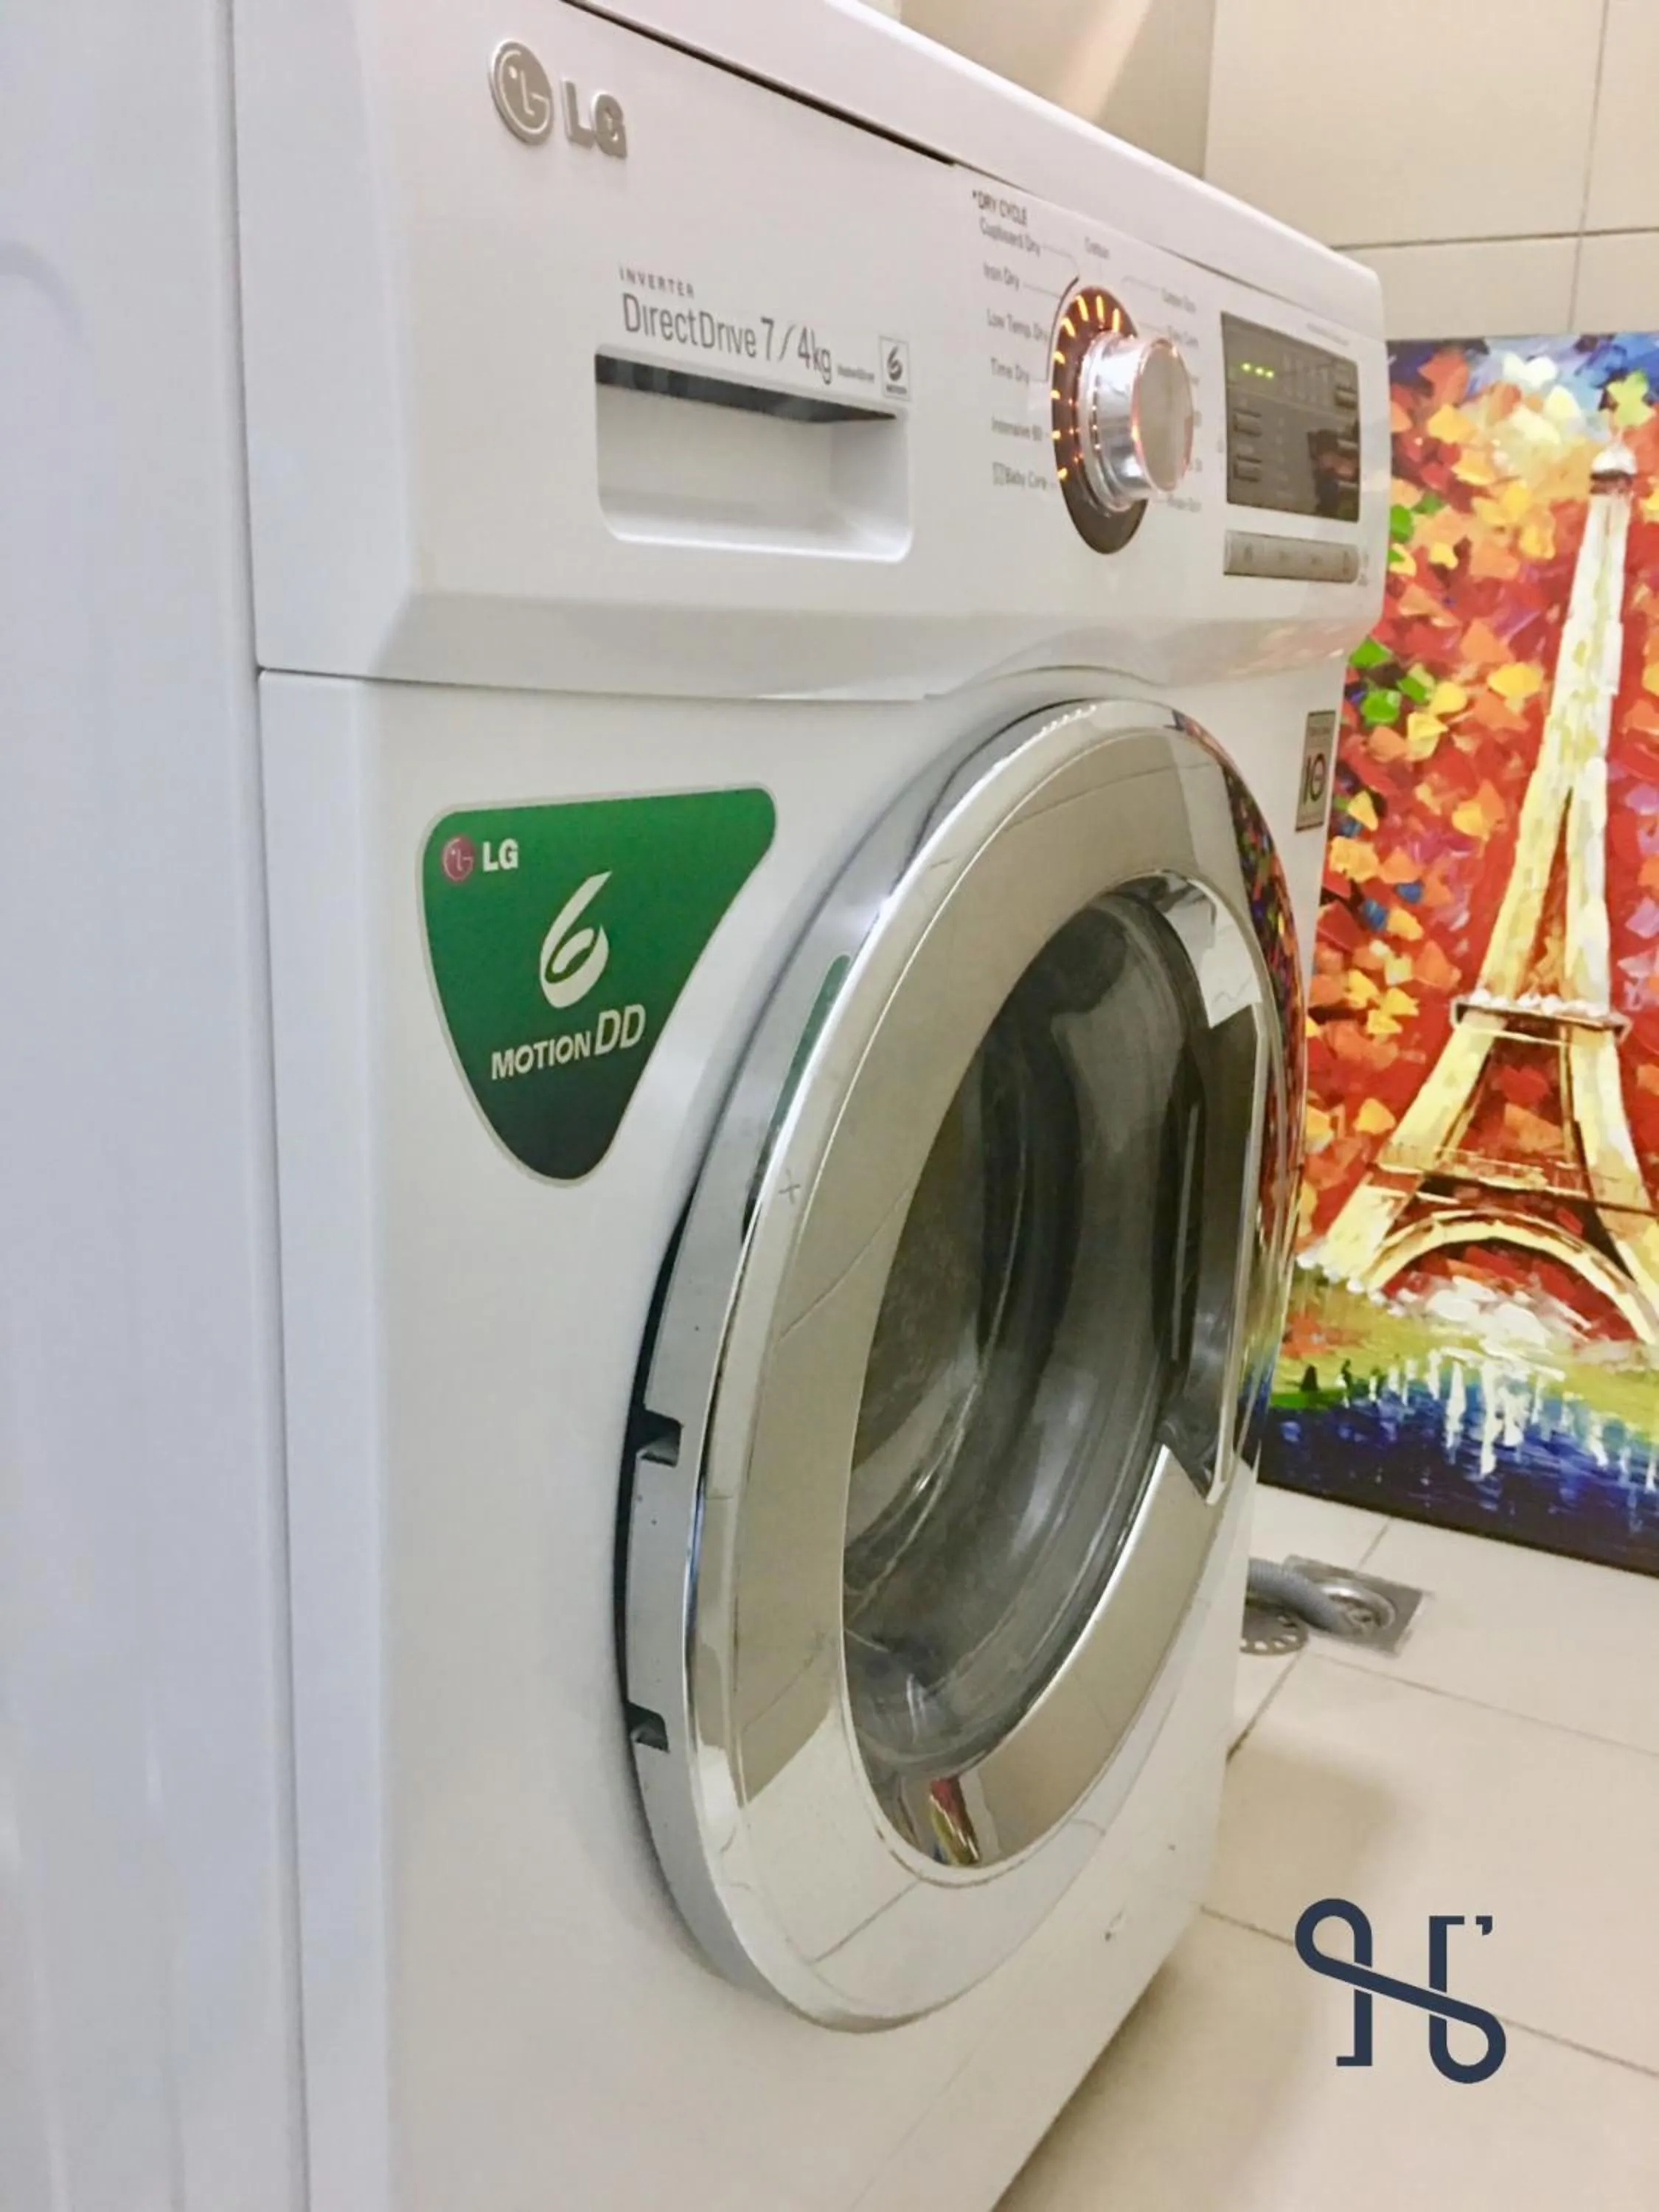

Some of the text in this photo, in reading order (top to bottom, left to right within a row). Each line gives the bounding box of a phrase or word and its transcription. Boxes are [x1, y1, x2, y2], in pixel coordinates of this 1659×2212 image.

[560, 78, 627, 159] LG
[619, 267, 695, 299] INVERTER
[482, 838, 518, 872] LG
[540, 871, 613, 1009] 6
